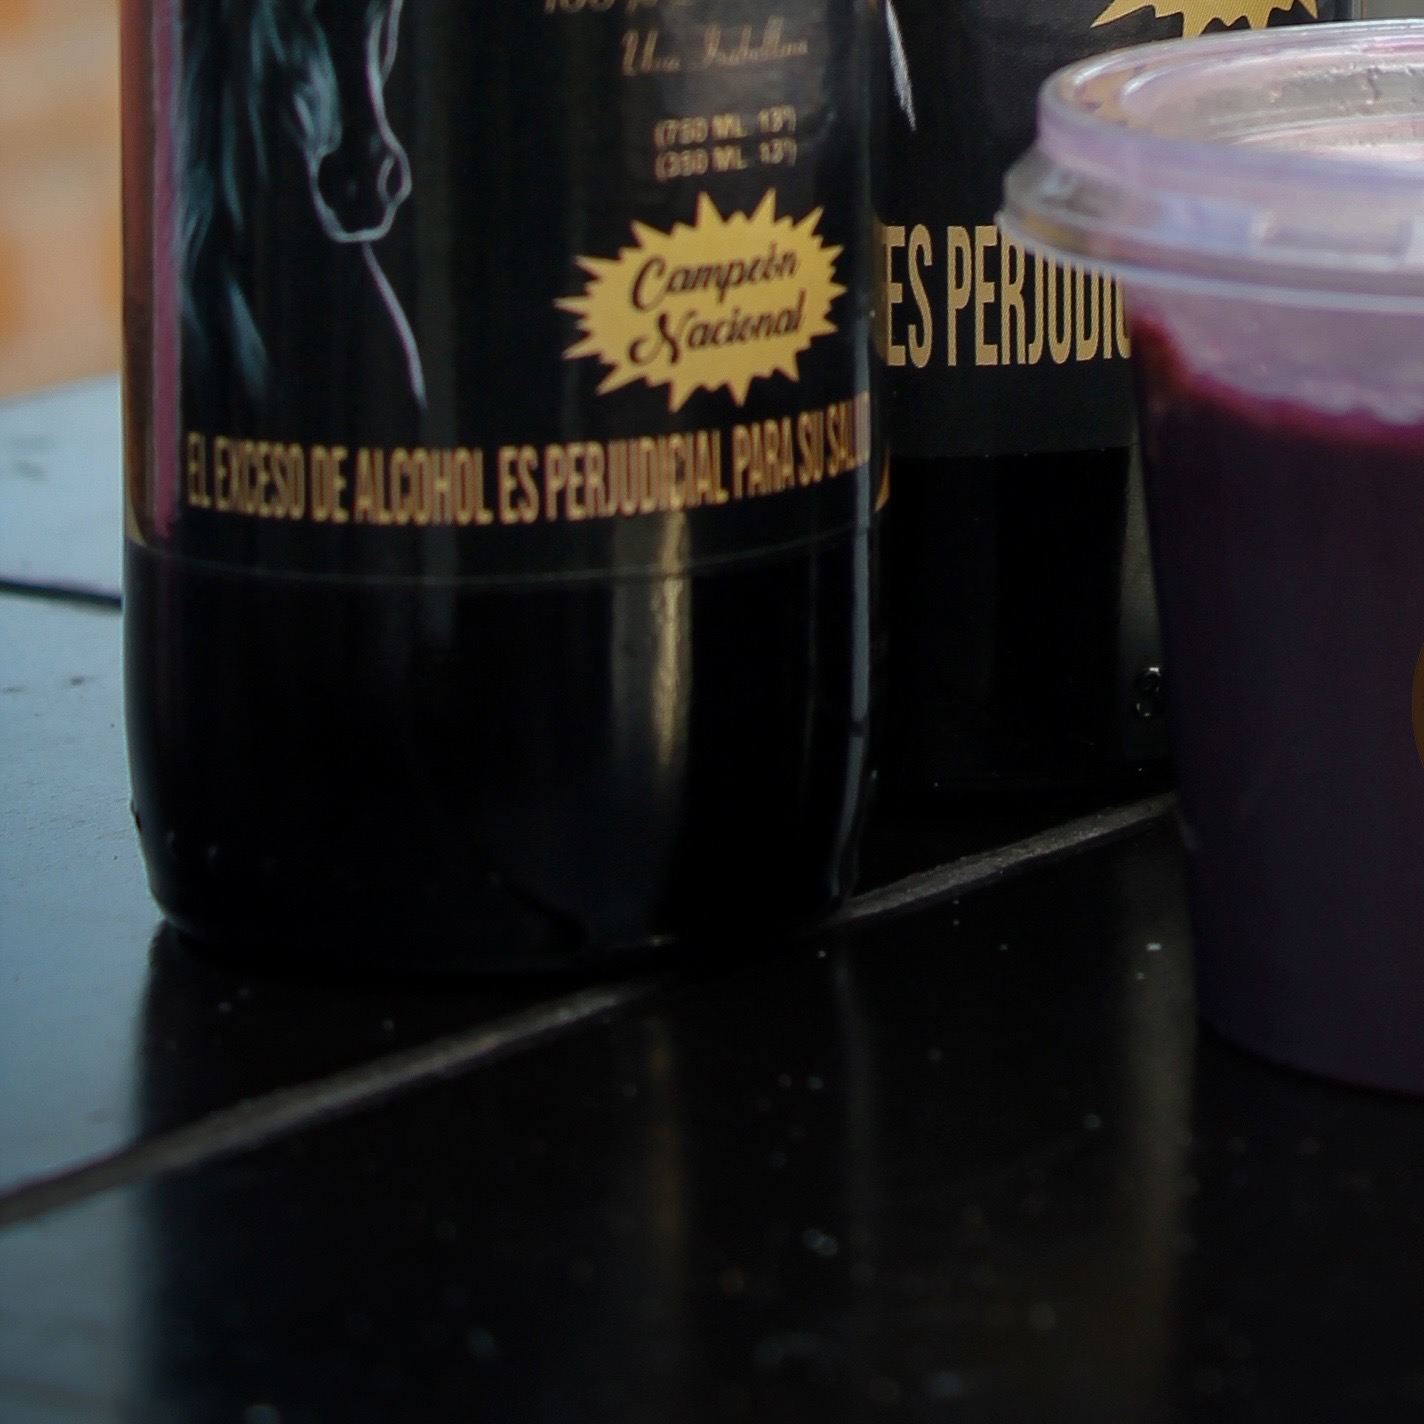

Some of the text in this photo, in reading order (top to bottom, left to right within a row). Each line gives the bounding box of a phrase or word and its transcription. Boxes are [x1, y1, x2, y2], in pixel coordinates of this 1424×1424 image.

[628, 289, 807, 364] Nacional
[884, 224, 932, 368] ES
[311, 444, 348, 522] DE
[354, 446, 494, 525] ALCOHOL
[499, 444, 540, 525] ES
[544, 428, 729, 522] PERJUDICIAL
[733, 416, 795, 500] PARA
